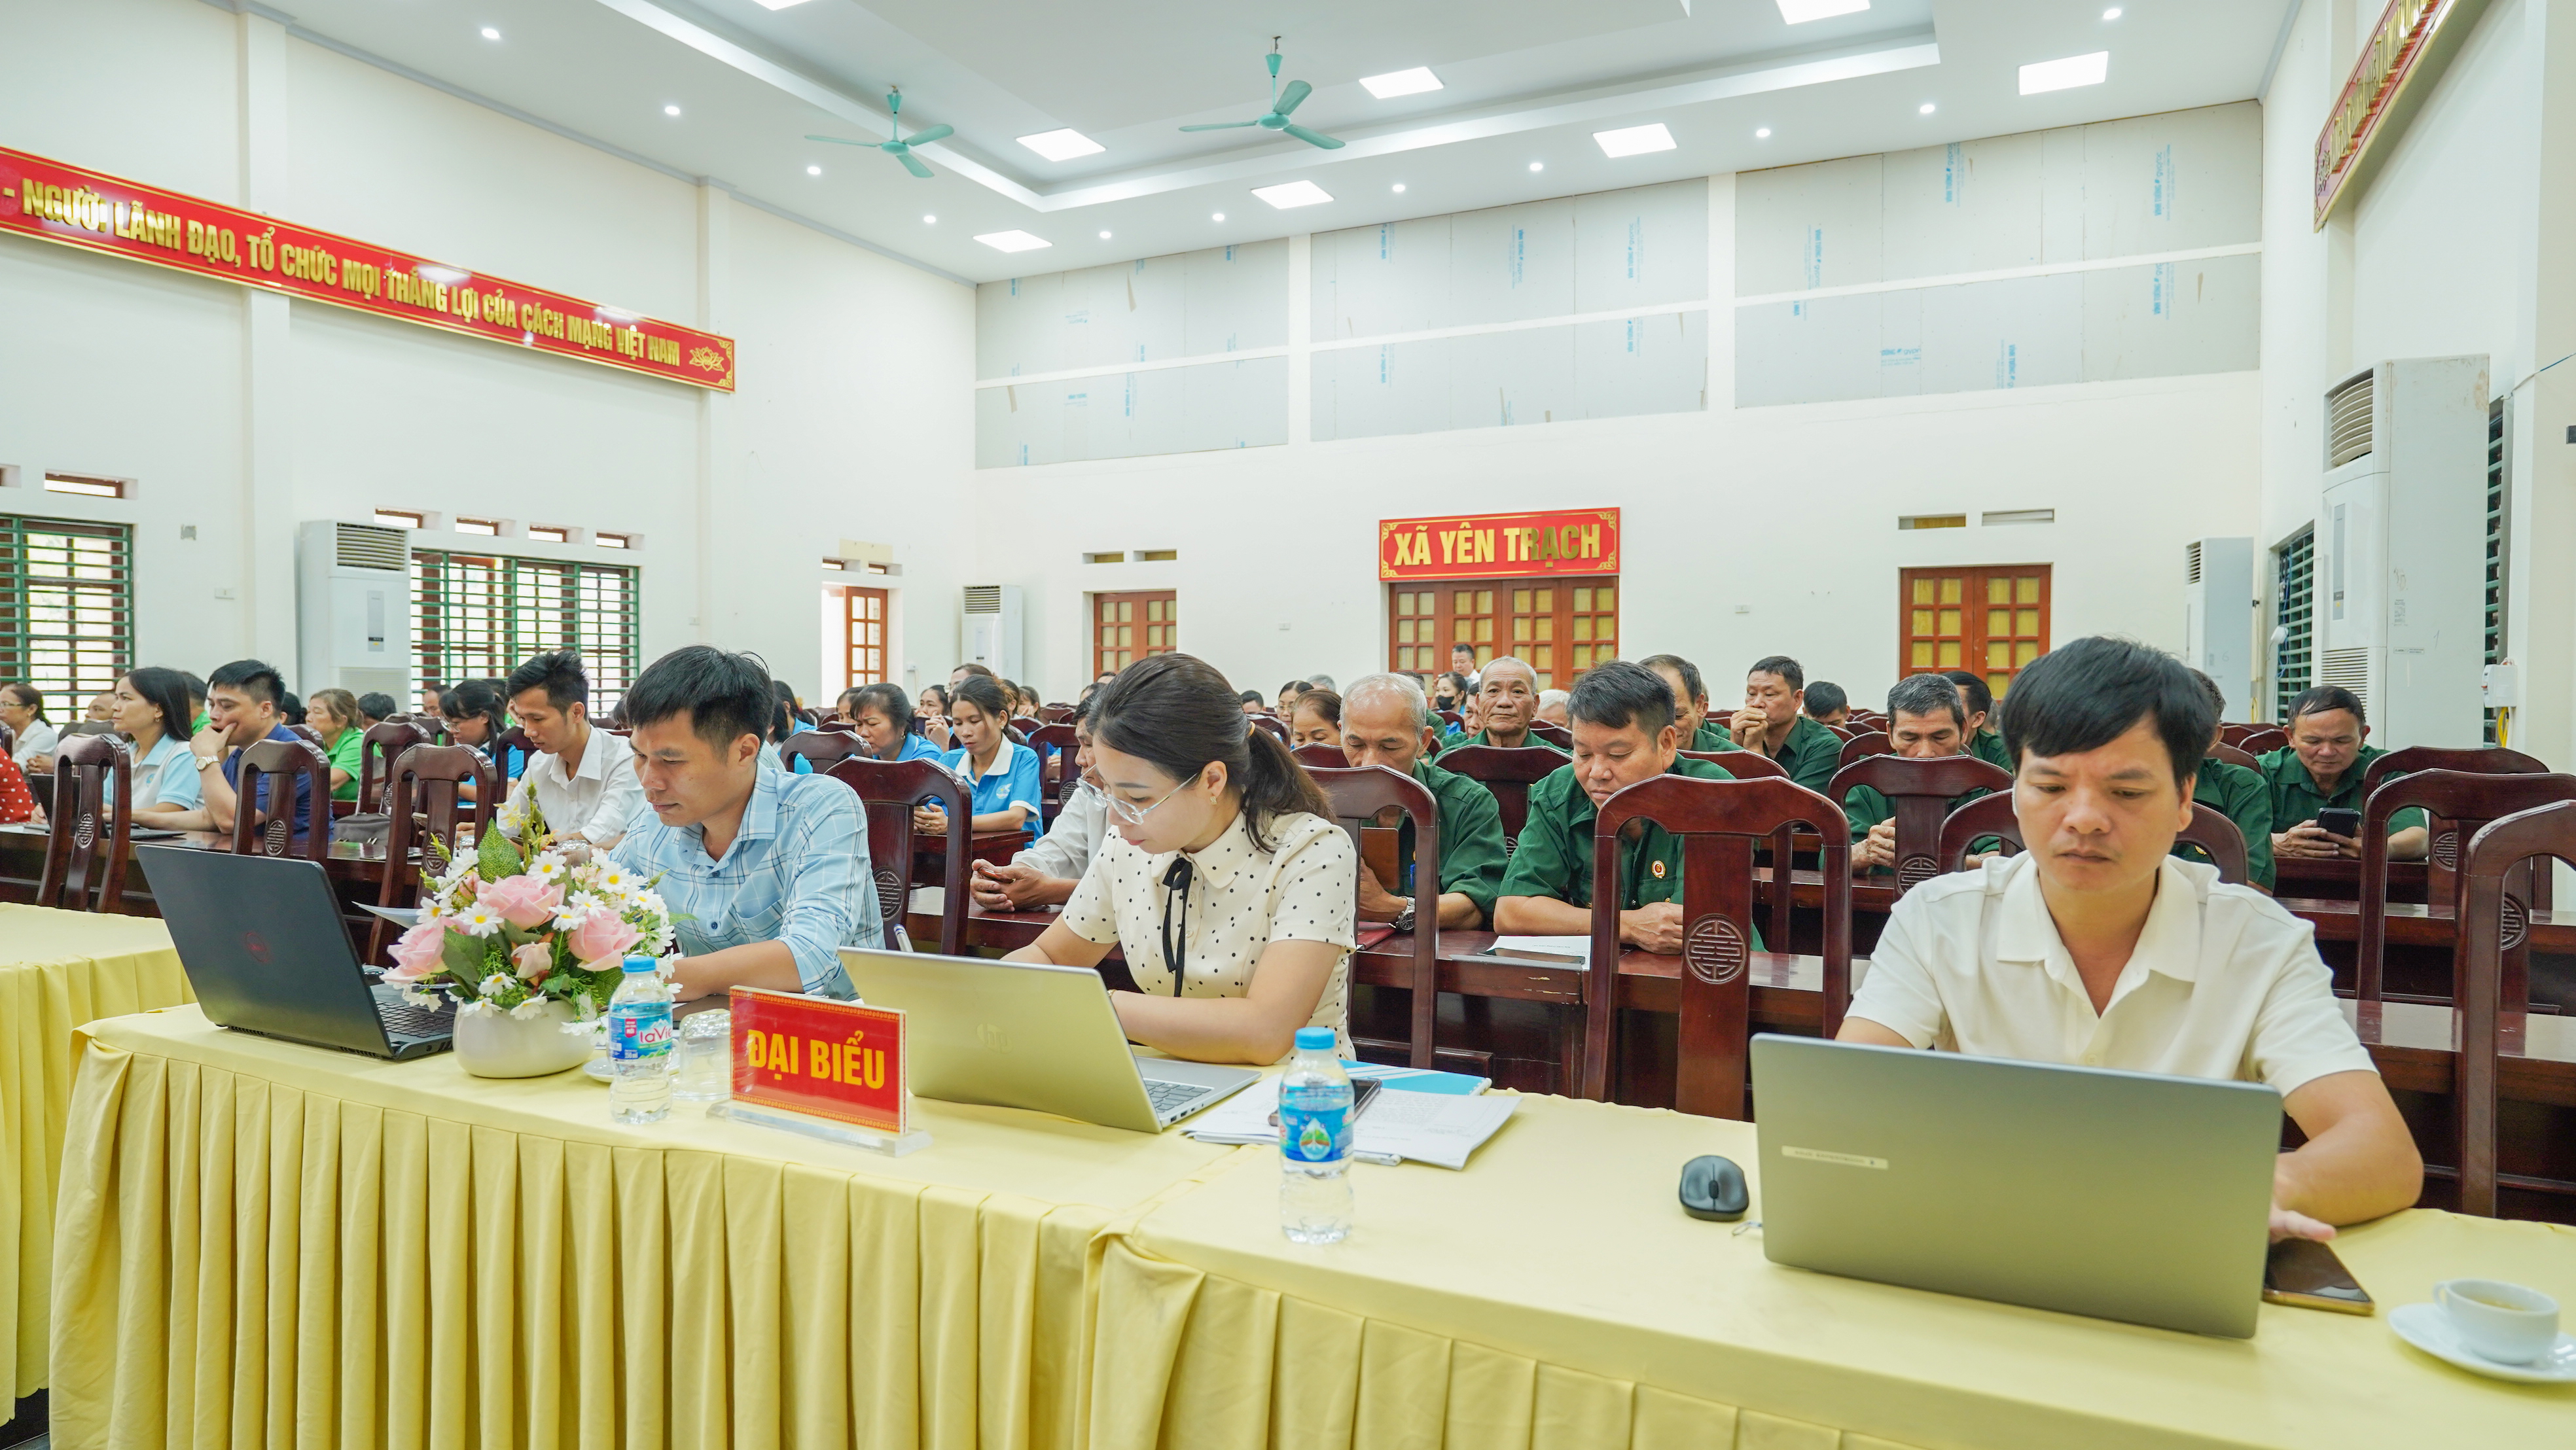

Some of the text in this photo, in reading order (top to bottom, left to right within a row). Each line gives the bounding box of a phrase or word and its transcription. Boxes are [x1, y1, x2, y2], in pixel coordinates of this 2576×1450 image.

[22, 178, 107, 232] NGƯỜI
[113, 200, 181, 250] LÃNH
[187, 219, 241, 268] ĐẠO,
[246, 226, 276, 272] TỔ
[280, 245, 337, 286] CHỨC
[342, 258, 380, 300] MỌI
[451, 286, 479, 323] LỢI
[482, 288, 517, 328] CỦA
[521, 302, 564, 340] CÁCH
[567, 315, 613, 351] MẠNG
[647, 335, 680, 366] NAM
[1393, 522, 1600, 568] XÃ YÊN TRẠCH
[747, 1029, 885, 1089] ĐẠI BIỂU
